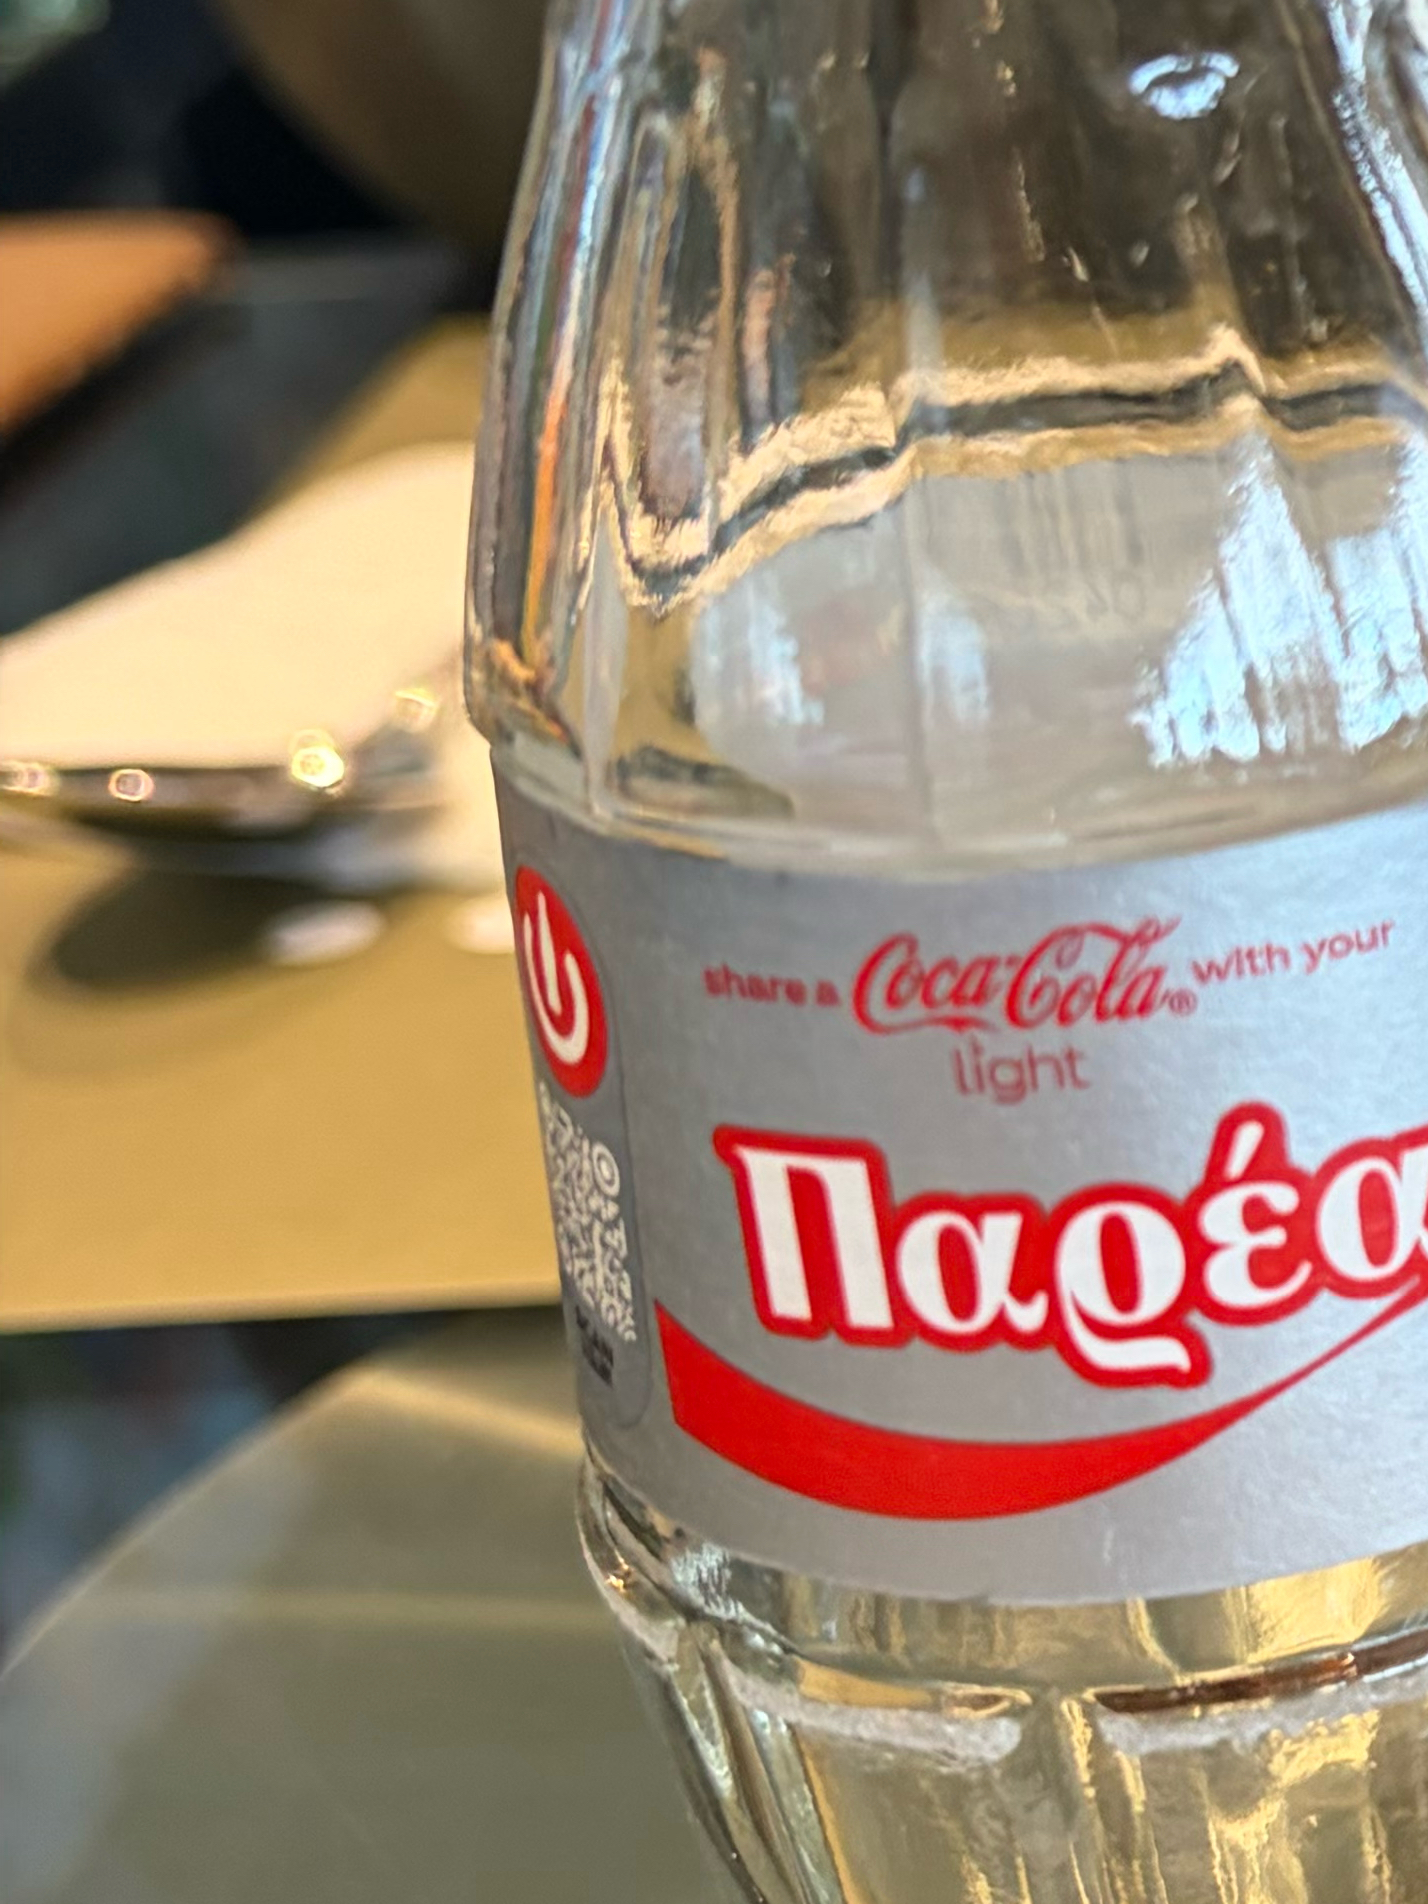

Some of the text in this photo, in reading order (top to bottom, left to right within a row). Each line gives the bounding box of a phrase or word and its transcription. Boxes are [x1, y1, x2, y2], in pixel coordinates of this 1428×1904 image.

[703, 964, 808, 1005] share
[814, 976, 842, 1007] a
[1191, 940, 1292, 986] with
[1301, 920, 1397, 974] your
[950, 1040, 1092, 1104] light
